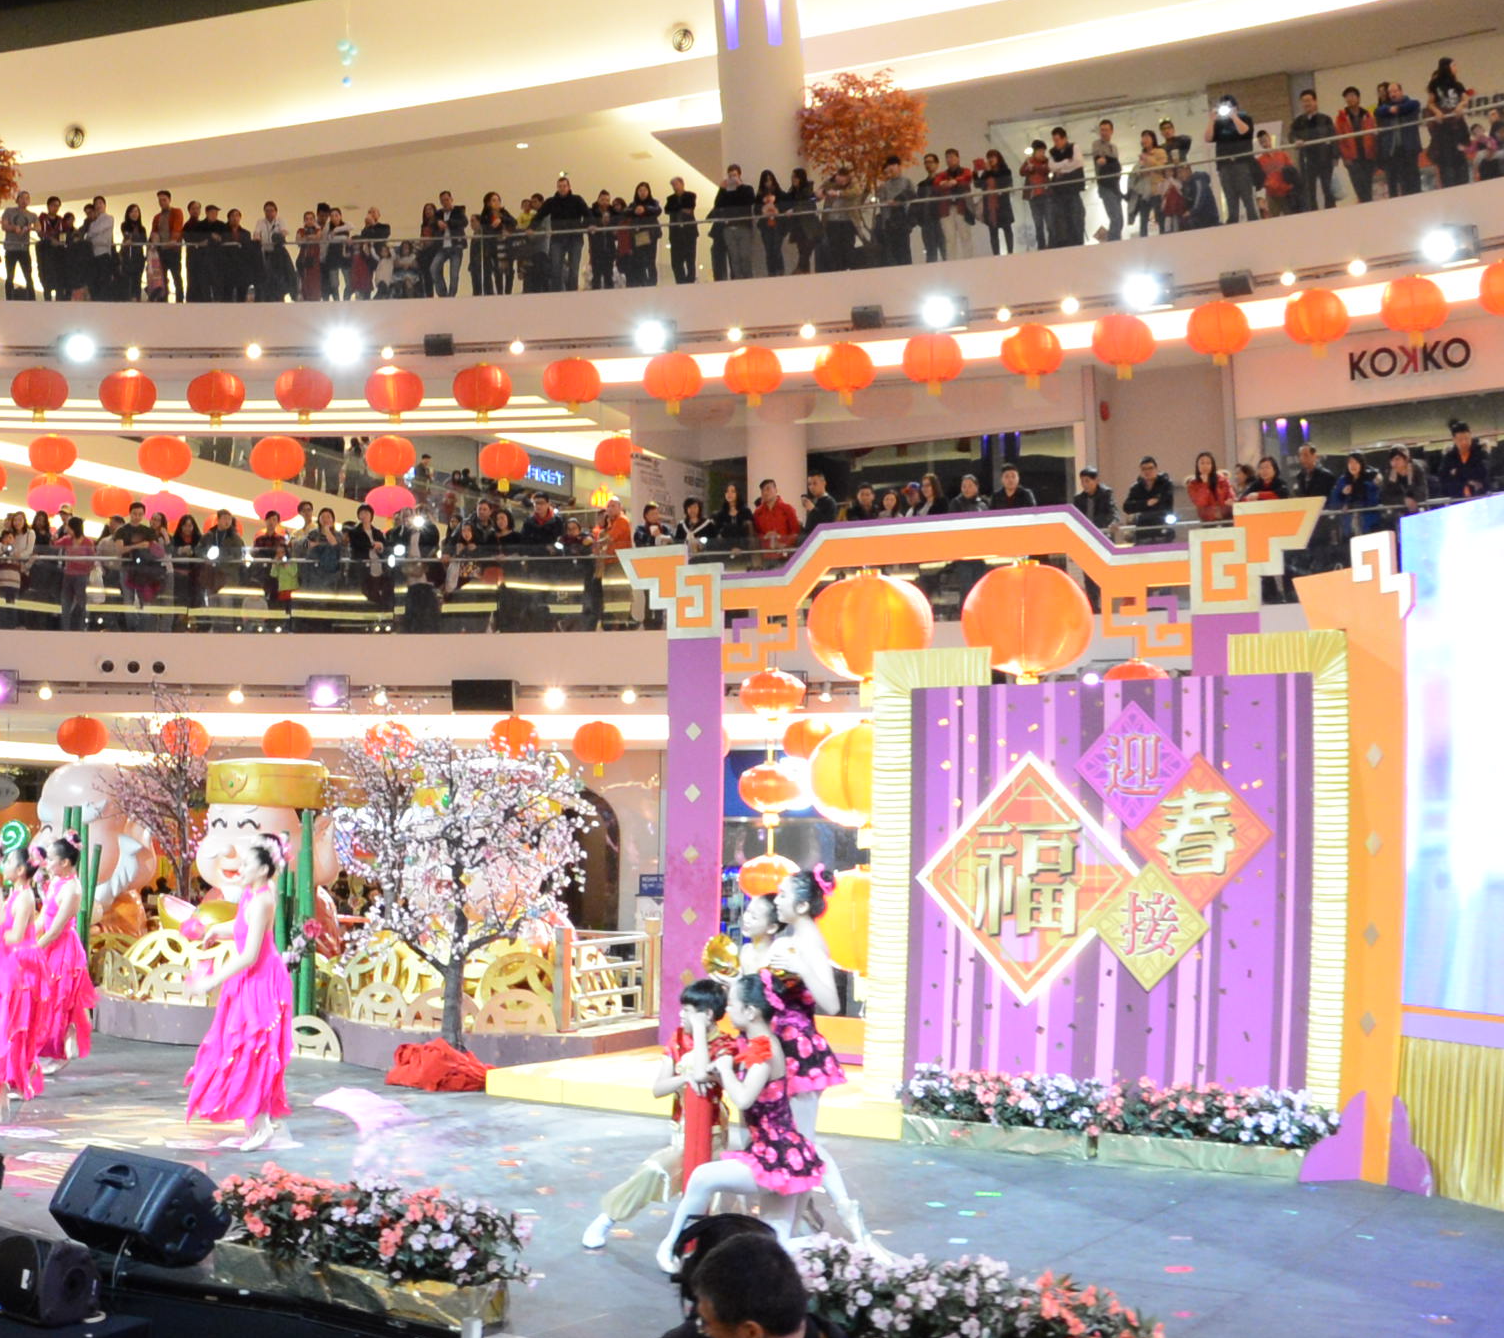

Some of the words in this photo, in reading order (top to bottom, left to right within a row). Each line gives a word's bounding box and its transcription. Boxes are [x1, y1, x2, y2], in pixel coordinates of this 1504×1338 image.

[1348, 337, 1471, 382] KOKKO
[1105, 733, 1162, 798] 迎
[1159, 787, 1236, 877] 春
[975, 817, 1084, 940] 福
[1119, 891, 1176, 959] 接
